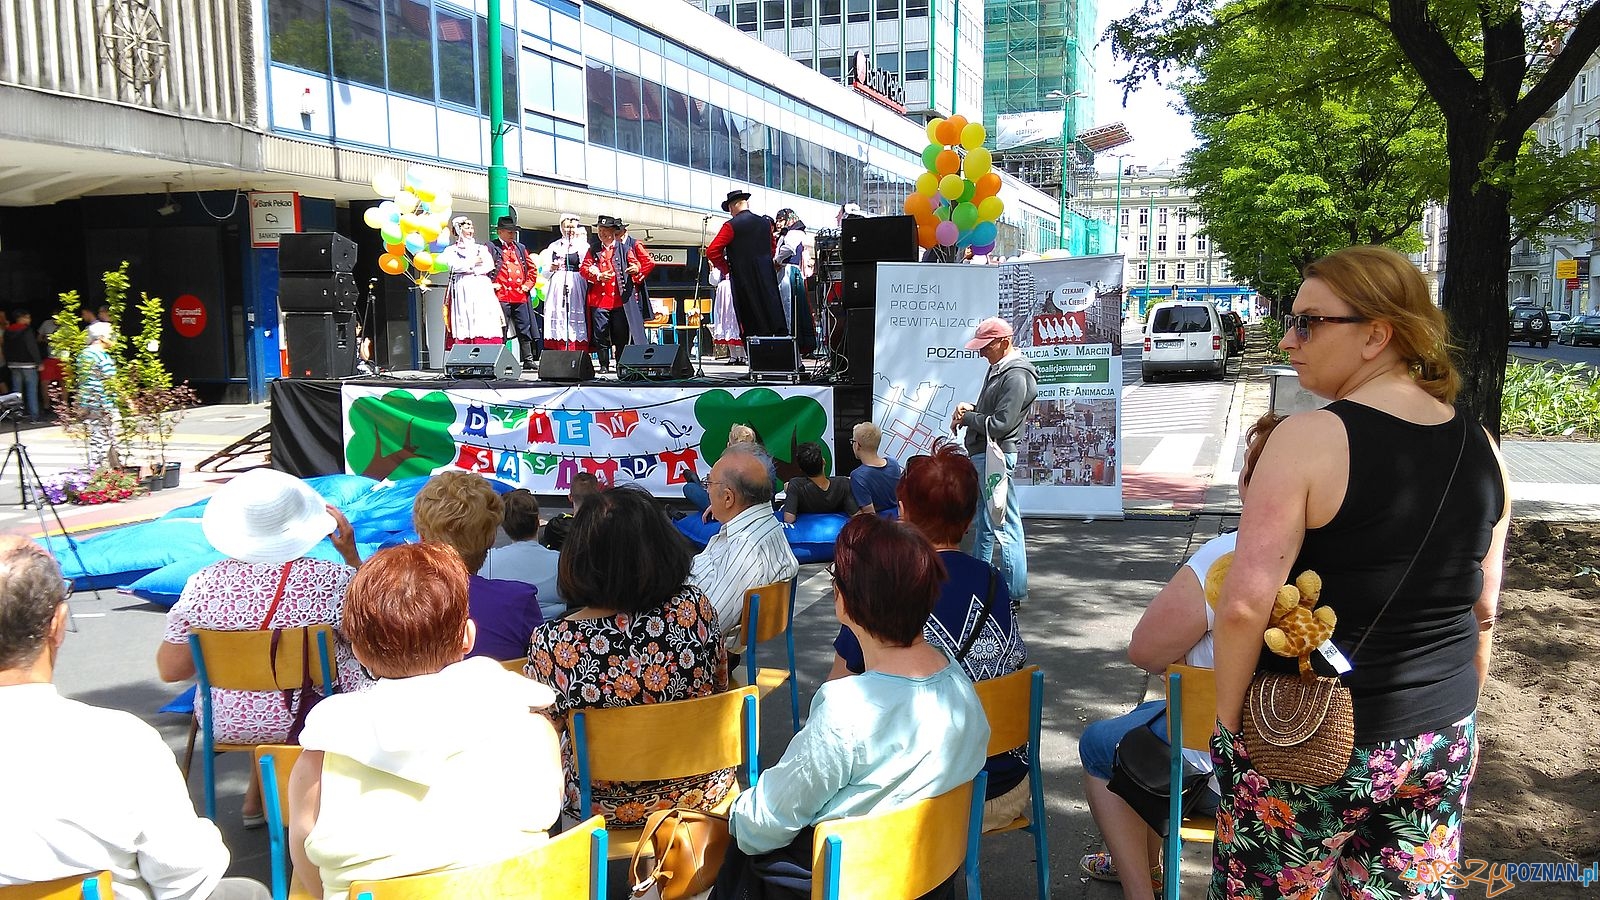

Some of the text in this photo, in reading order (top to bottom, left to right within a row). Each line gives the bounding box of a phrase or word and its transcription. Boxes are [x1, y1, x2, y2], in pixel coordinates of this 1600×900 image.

[867, 57, 887, 97] Bank
[891, 284, 940, 294] MIEJSKI
[890, 300, 957, 311] PROGRAM
[890, 316, 984, 328] REWITALIZACJ
[1076, 346, 1110, 356] MARCIN
[1038, 389, 1056, 398] RCIN
